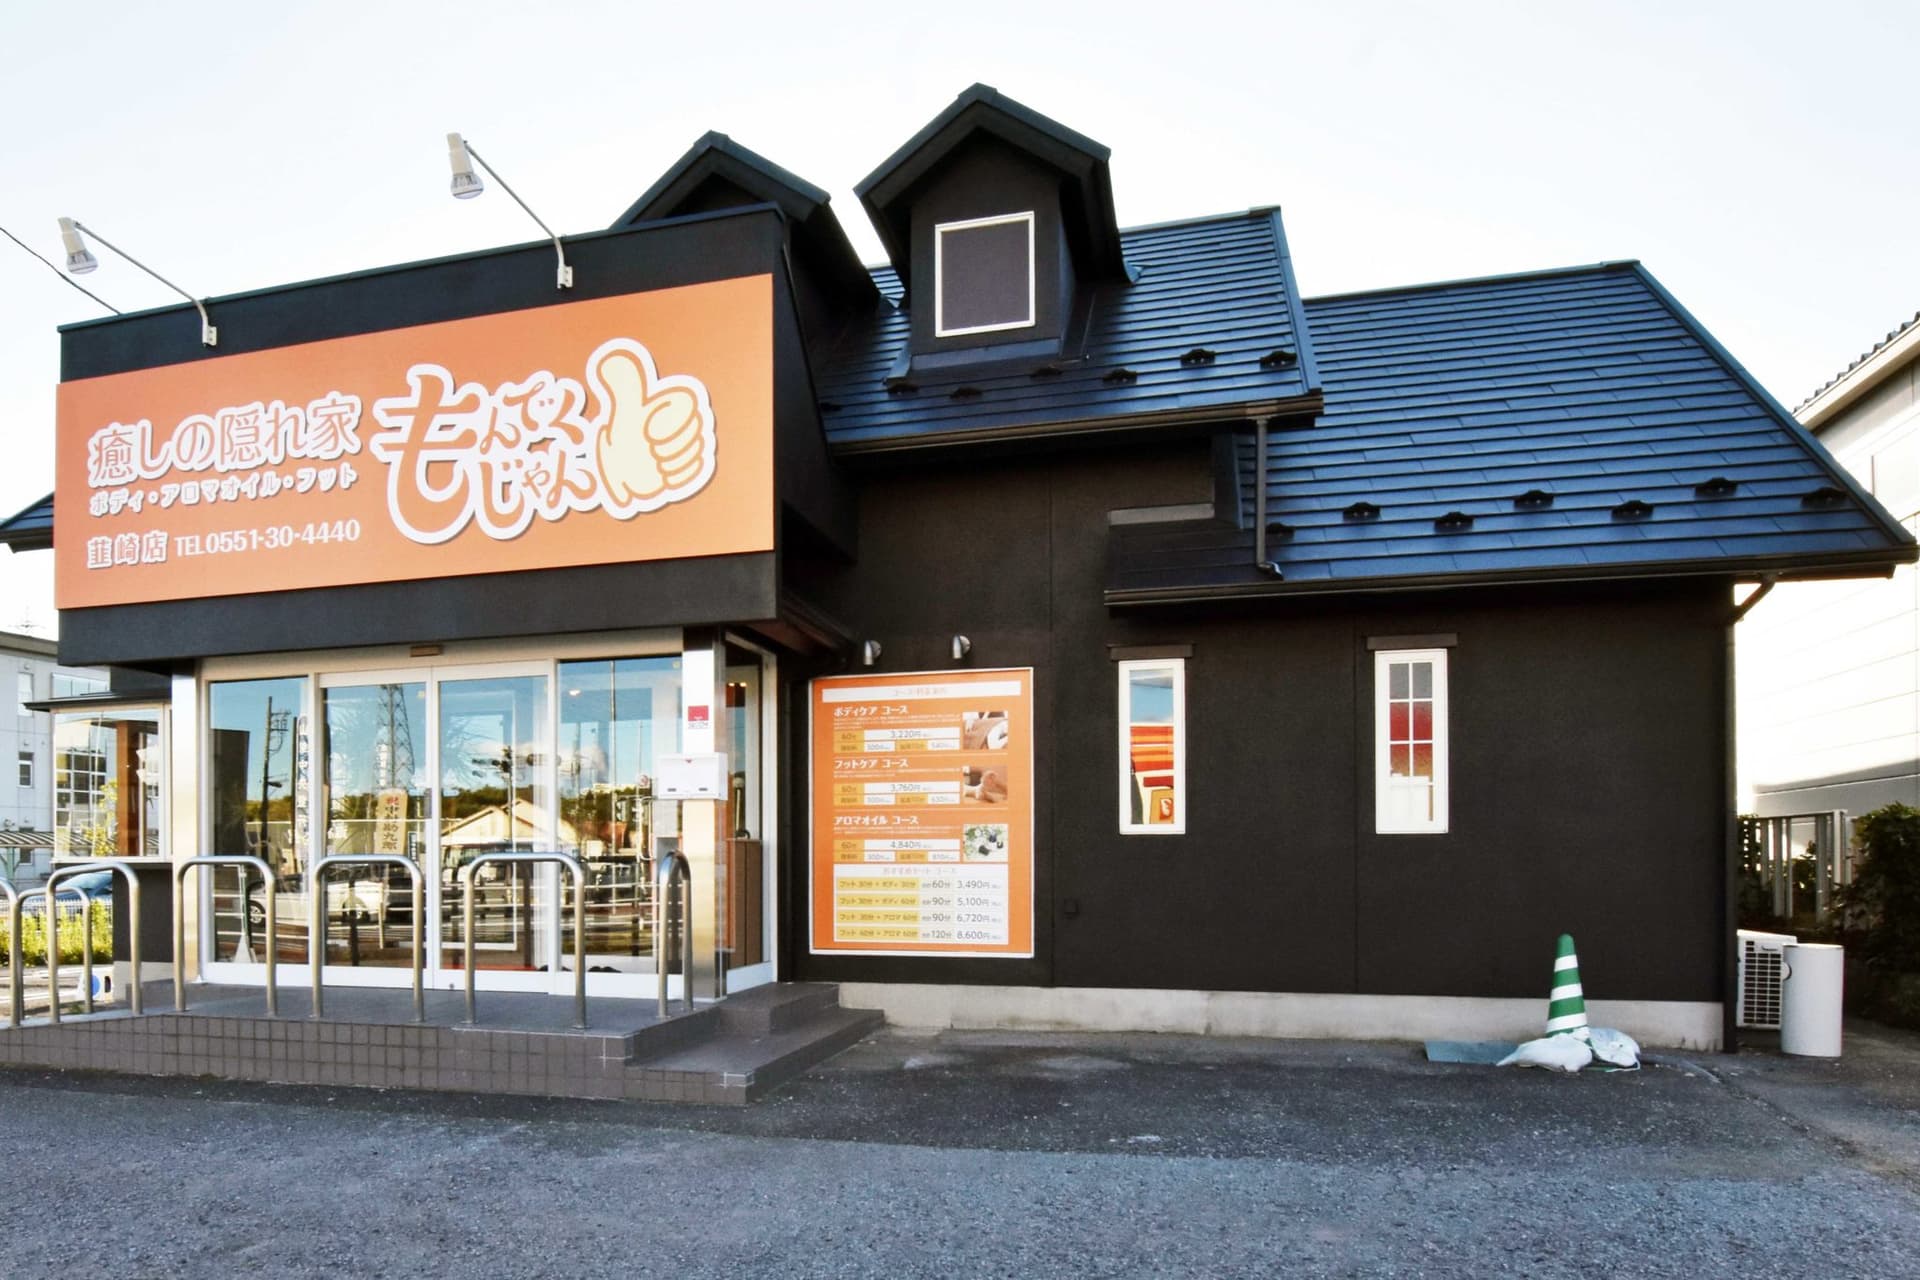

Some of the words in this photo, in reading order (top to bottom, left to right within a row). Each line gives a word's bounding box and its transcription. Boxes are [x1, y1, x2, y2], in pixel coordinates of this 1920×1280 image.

[88, 391, 361, 487] 癒しの隠れ家
[89, 463, 357, 516] ボディ・アロマオイル・フット
[87, 530, 168, 569] 韮崎店
[206, 519, 360, 554] 0551-30-4440
[882, 705, 909, 715] コース
[835, 759, 878, 769] フットケア
[882, 758, 909, 768] コース
[892, 815, 919, 825] コース
